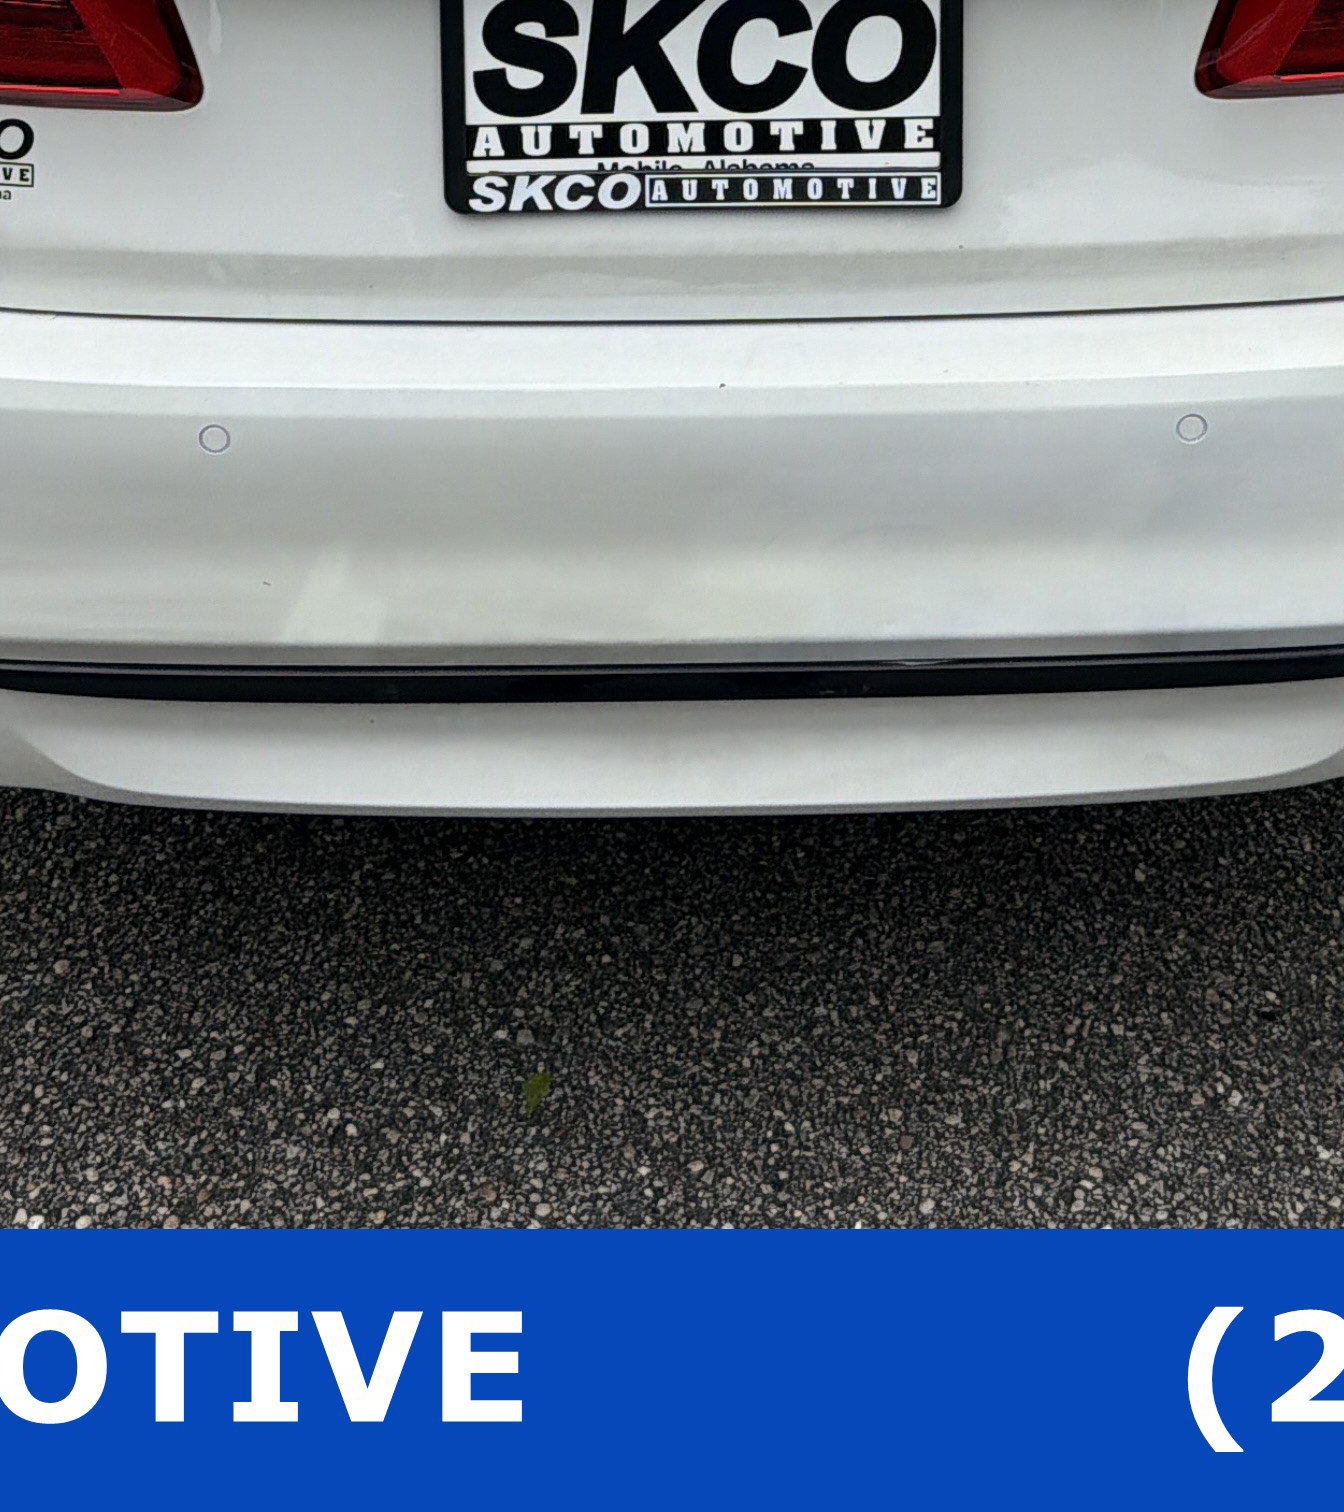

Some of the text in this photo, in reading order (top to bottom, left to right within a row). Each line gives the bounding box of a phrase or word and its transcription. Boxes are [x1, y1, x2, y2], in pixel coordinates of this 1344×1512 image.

[472, 118, 936, 158] AUTOMOTIVE
[468, 172, 937, 213] SKCO AUTOMOTIVE
